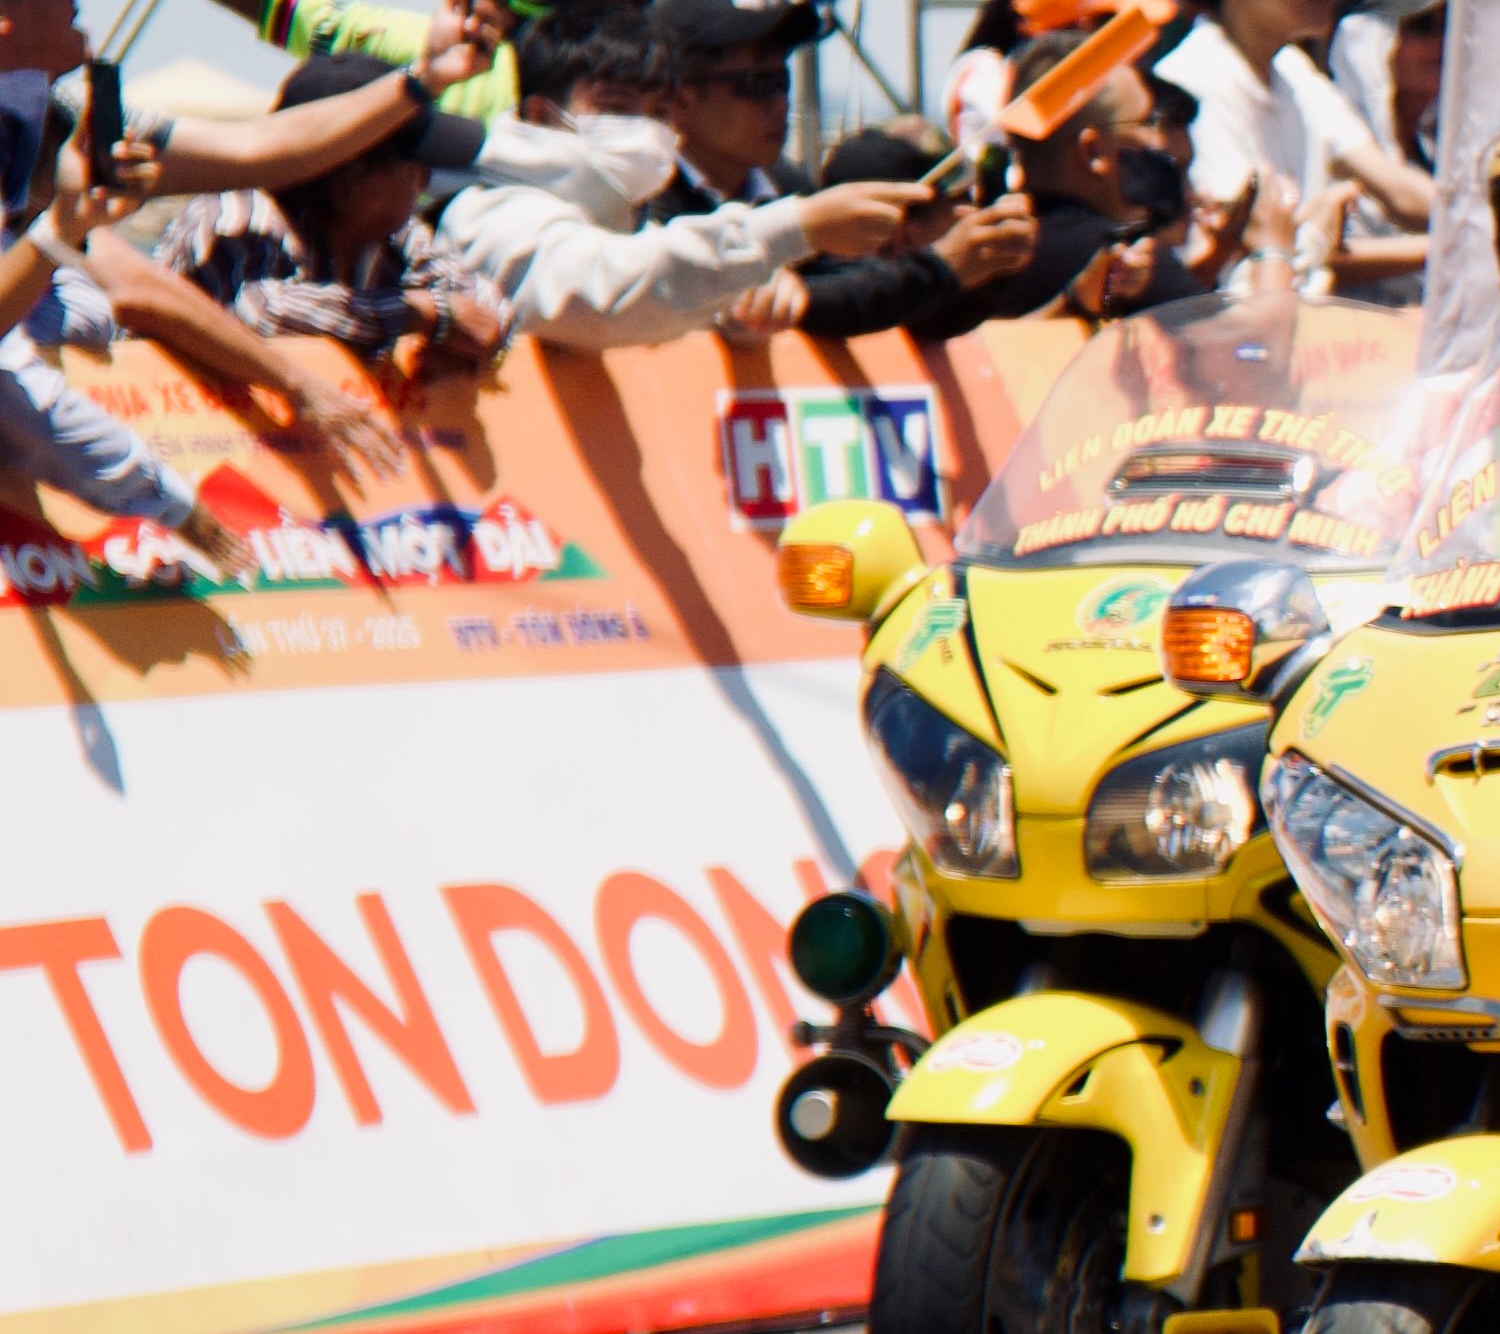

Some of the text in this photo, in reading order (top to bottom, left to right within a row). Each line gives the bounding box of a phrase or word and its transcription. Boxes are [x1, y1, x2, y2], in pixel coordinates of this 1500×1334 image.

[729, 405, 933, 509] HTV
[1205, 405, 1261, 439] XE
[1287, 510, 1380, 558] MINH
[1417, 461, 1500, 560] LIÊN
[0, 889, 478, 1157] TON
